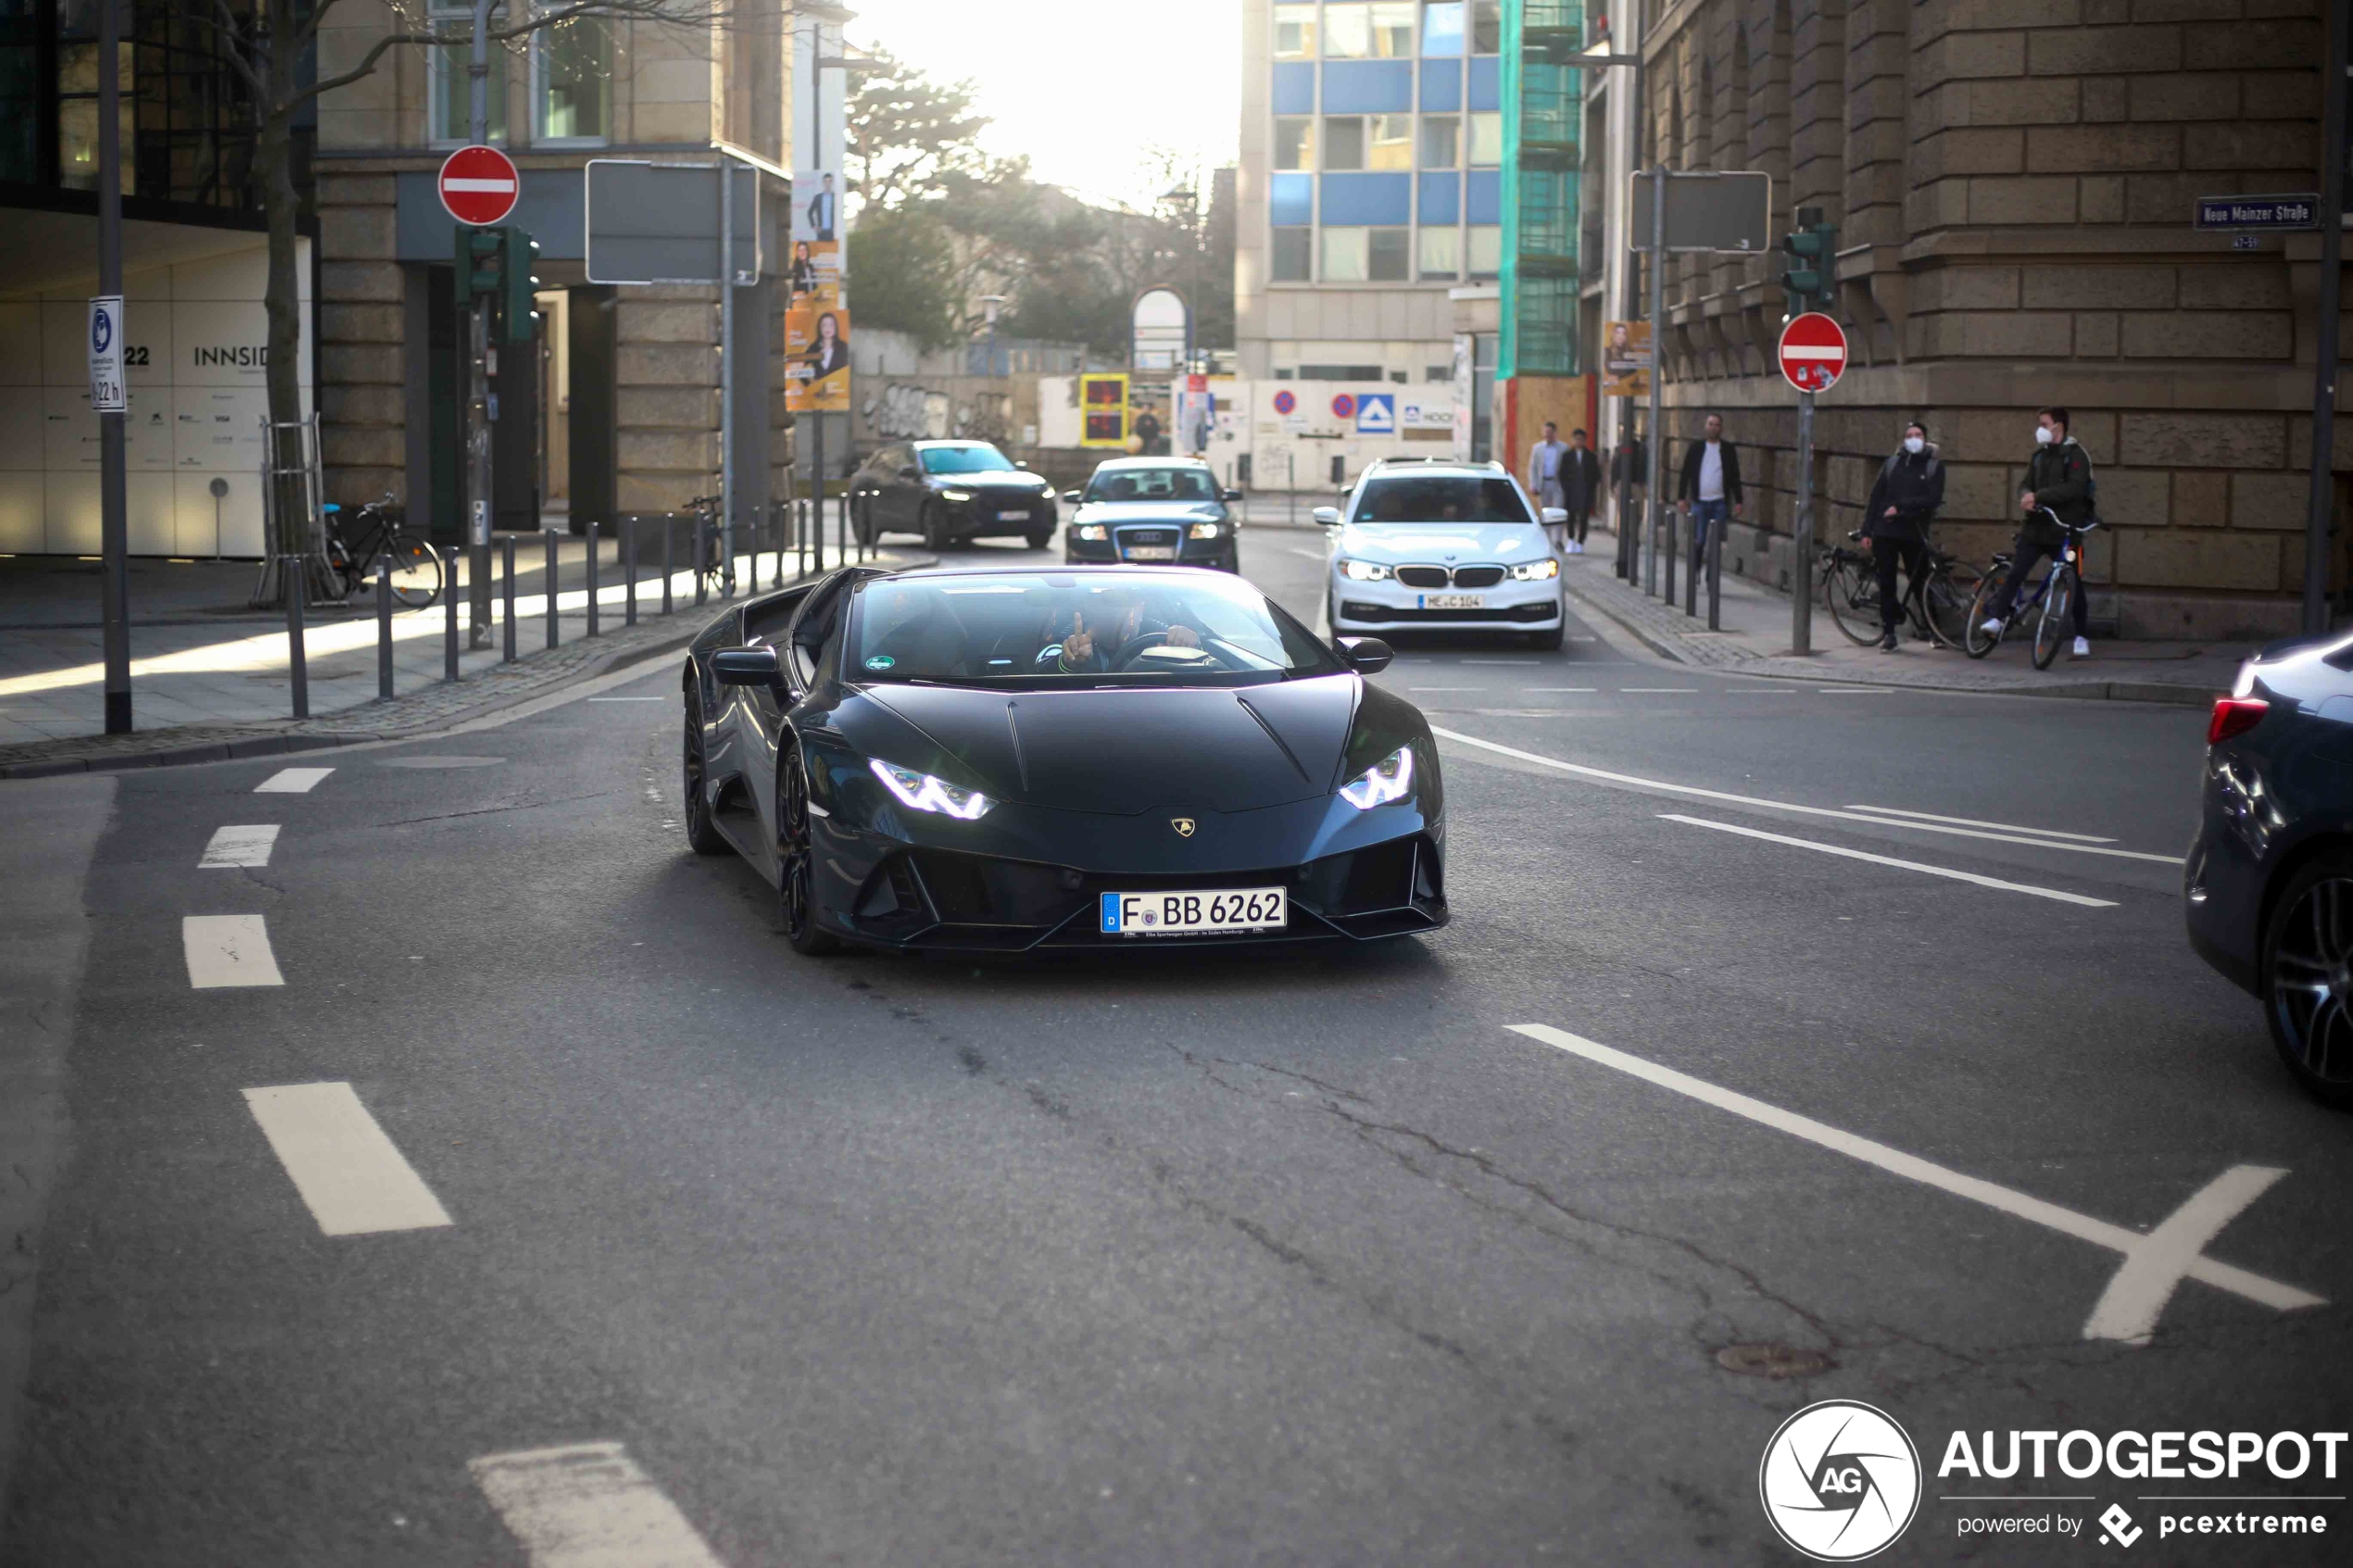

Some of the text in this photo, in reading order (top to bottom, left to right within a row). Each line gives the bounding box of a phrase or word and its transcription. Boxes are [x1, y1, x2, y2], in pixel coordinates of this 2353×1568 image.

[2205, 205, 2309, 221] Neue Mainzer Straße
[1123, 893, 1280, 926] F BB 6262
[1108, 917, 1115, 925] D
